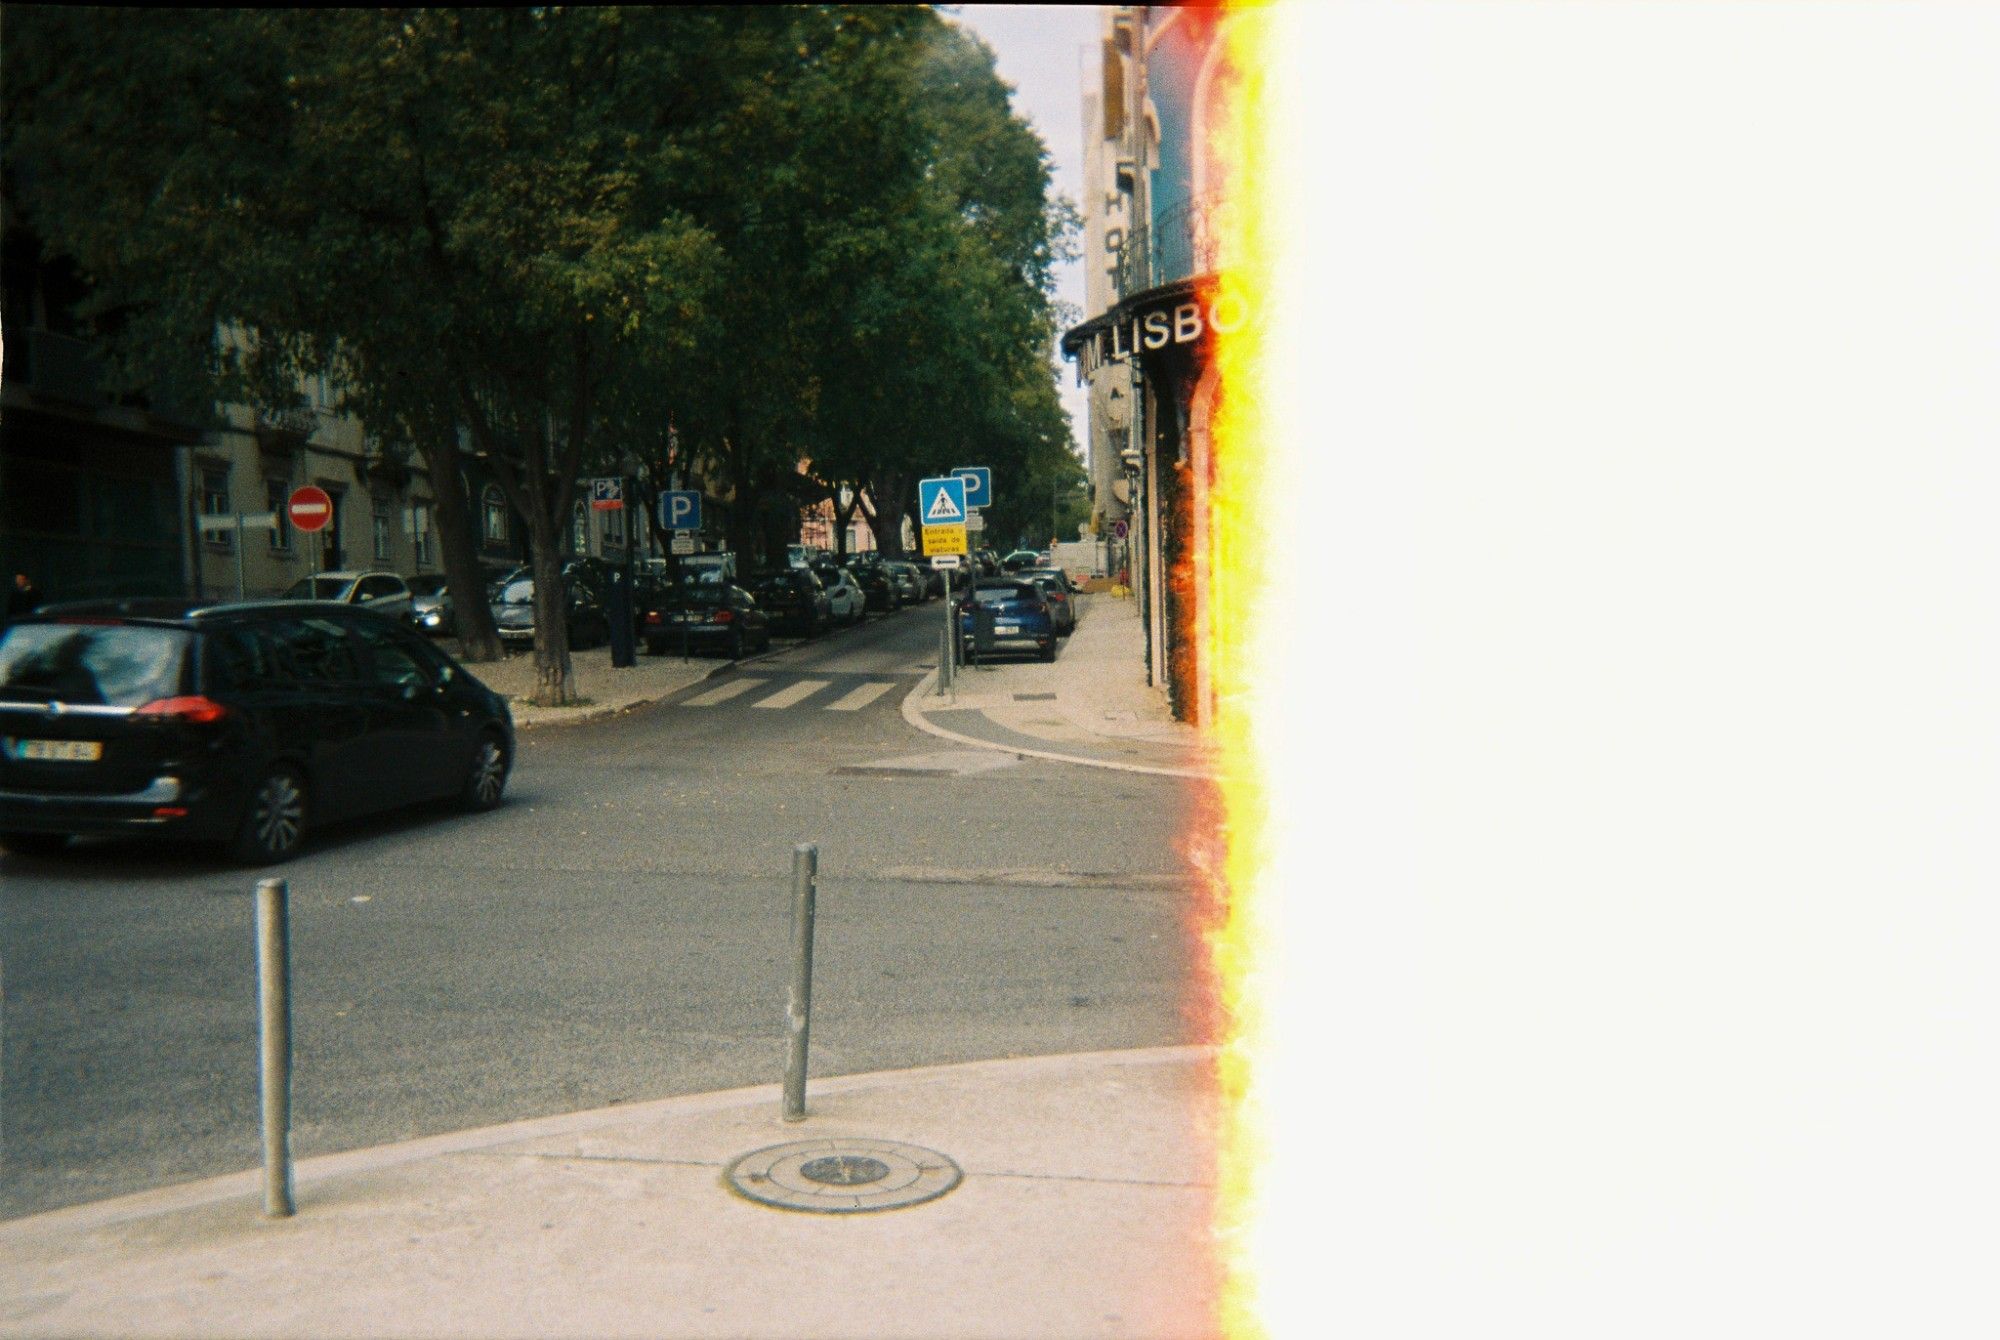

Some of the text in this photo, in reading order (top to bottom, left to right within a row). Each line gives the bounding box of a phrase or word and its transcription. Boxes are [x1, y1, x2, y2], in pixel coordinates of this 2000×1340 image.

[597, 481, 607, 496] P
[961, 473, 981, 492] P
[671, 495, 692, 525] P
